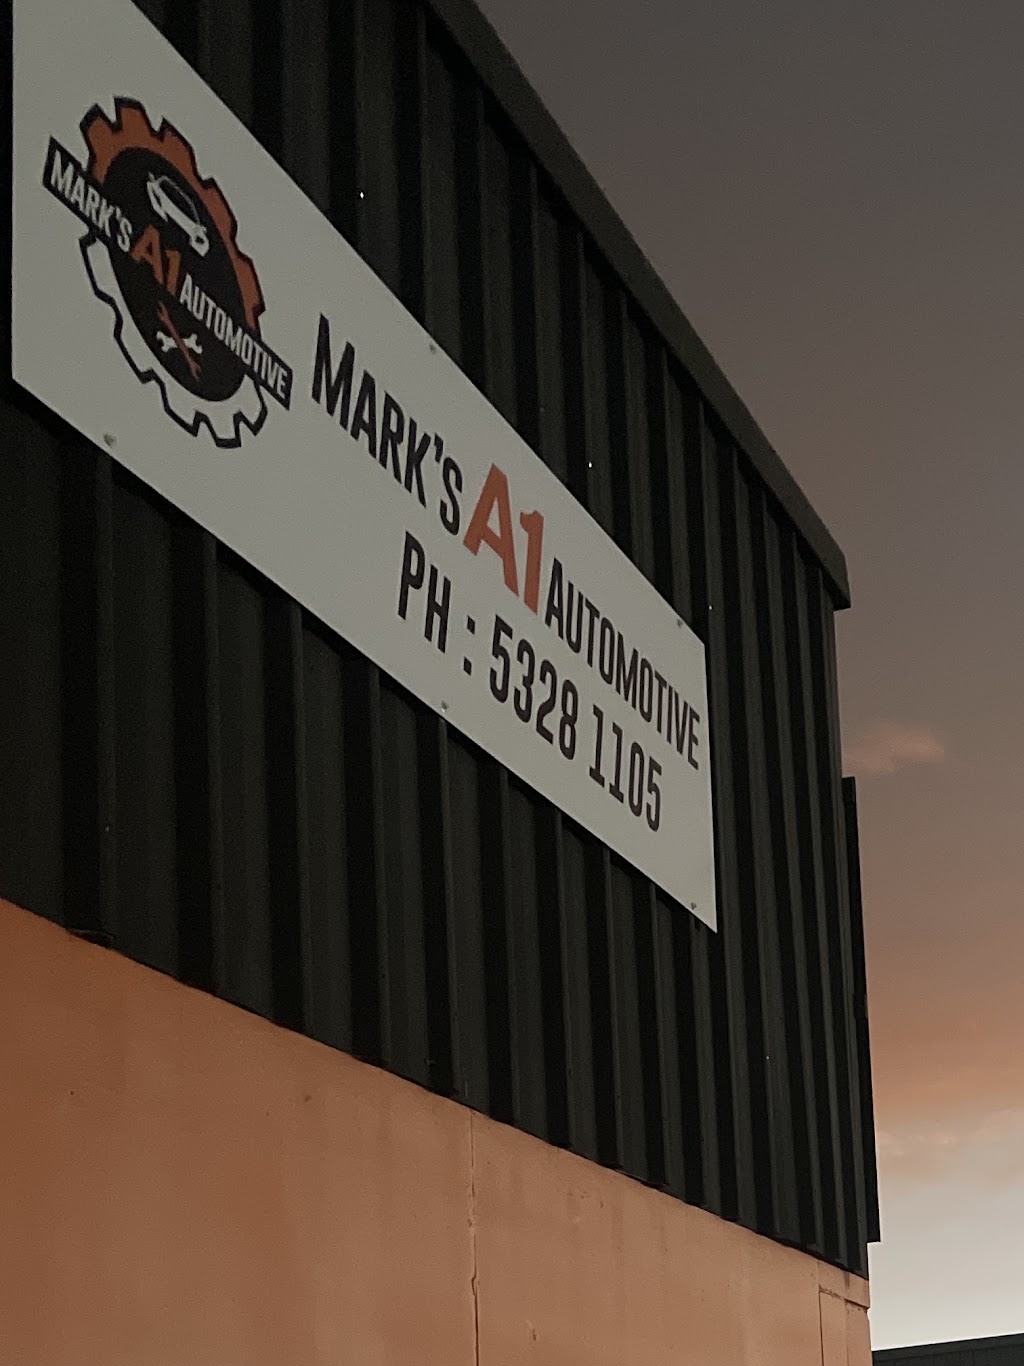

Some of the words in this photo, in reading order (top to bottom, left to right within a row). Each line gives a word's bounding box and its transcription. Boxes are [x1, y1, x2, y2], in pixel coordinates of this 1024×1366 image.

[50, 149, 133, 253] MARK'S
[130, 223, 182, 297] A1
[179, 273, 289, 399] AUTOMOTIVE
[311, 311, 464, 537] MARK'S
[462, 462, 545, 616] A1
[544, 556, 700, 771] AUTOMOTIVE
[488, 613, 580, 761] 5328
[588, 703, 663, 833] 1105
